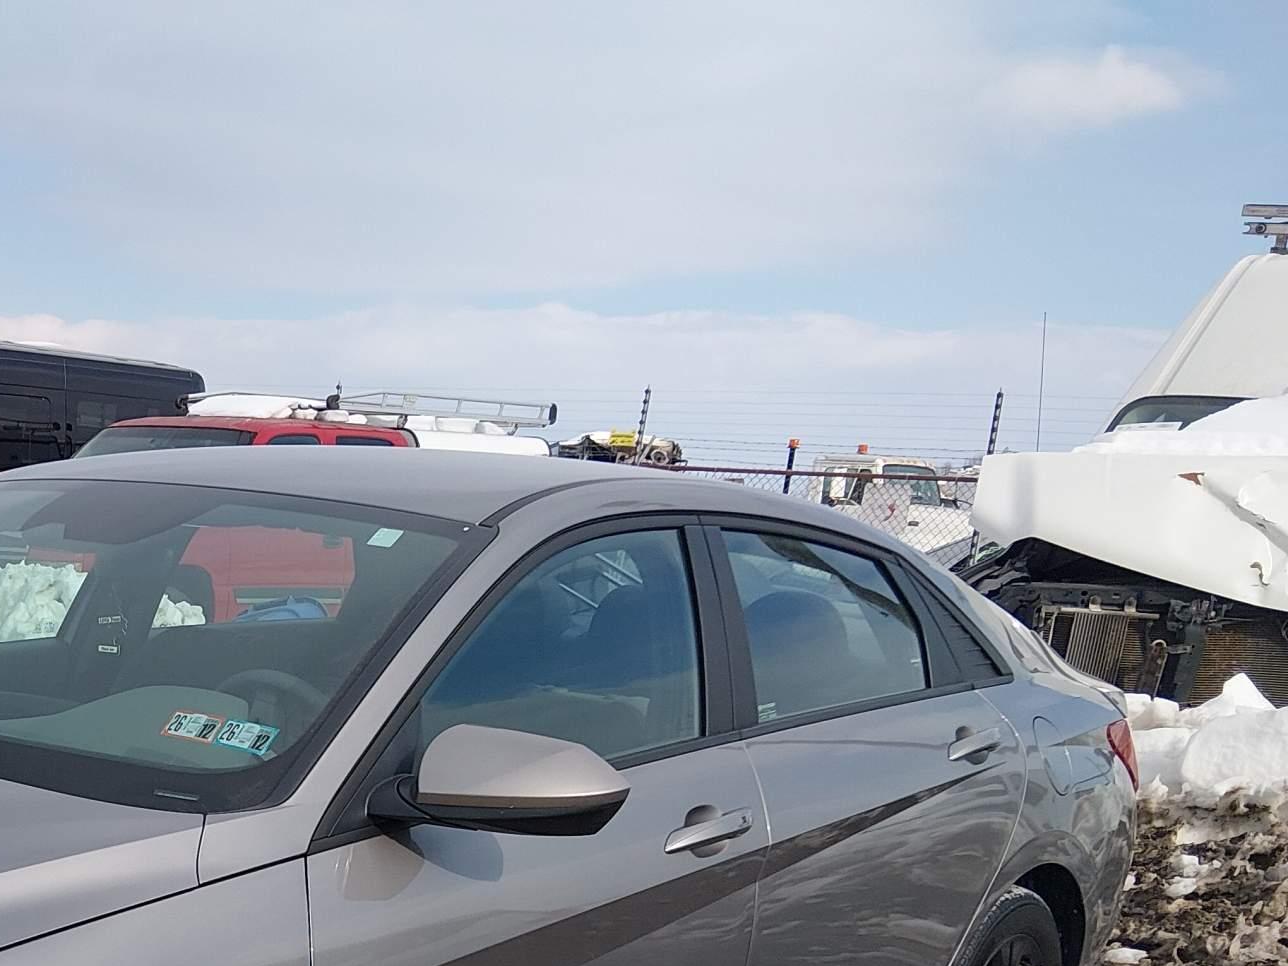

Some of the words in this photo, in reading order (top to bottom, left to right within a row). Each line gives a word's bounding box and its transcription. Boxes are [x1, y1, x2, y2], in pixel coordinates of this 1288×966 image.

[168, 713, 187, 732] 26
[197, 723, 217, 739] 12
[219, 722, 241, 741] 26
[250, 734, 271, 751] 12
